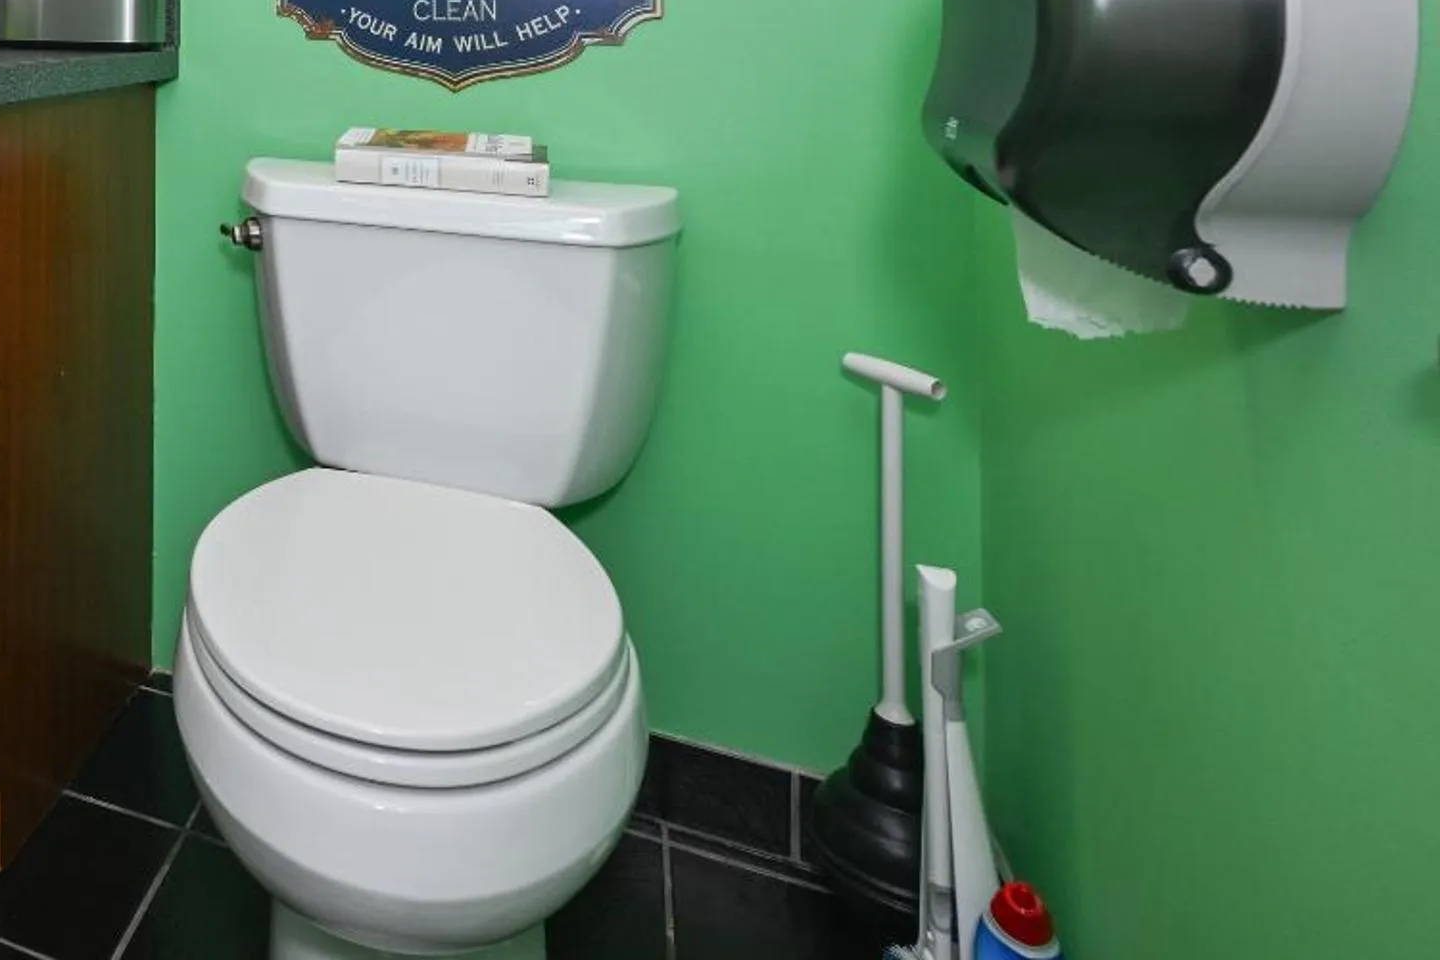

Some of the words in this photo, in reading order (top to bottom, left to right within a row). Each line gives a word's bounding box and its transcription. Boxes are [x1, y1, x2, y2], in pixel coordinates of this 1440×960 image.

[412, 0, 497, 22] CLEAN
[347, 6, 398, 40] YOUR
[405, 33, 443, 54] AIM
[452, 30, 509, 54] WILL
[515, 5, 572, 39] HELP
